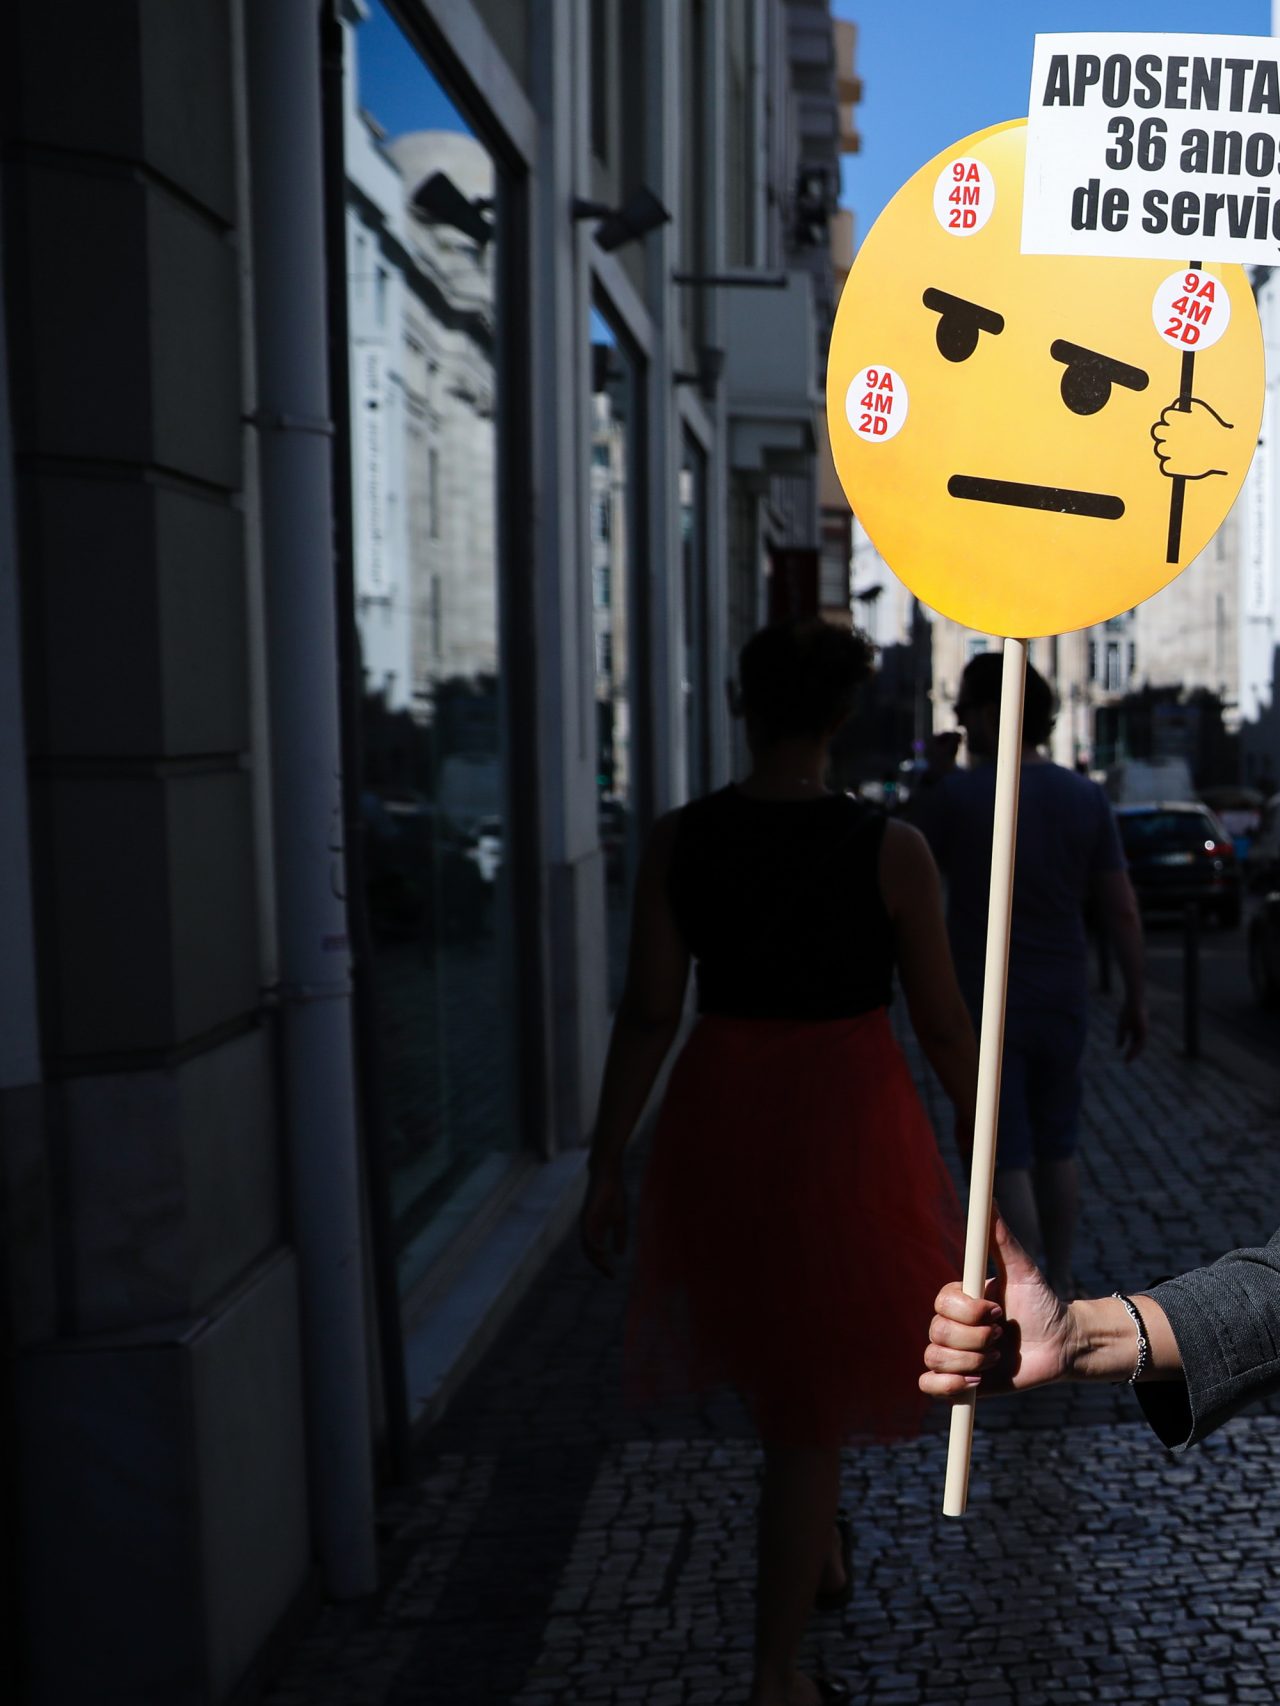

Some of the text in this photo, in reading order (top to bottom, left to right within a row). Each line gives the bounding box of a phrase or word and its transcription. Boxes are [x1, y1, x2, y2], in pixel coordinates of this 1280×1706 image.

[1105, 116, 1168, 171] 36
[953, 162, 981, 183] 9A
[948, 185, 981, 205] 4M
[1071, 178, 1130, 231] de
[948, 208, 977, 229] 2D
[1183, 272, 1215, 303] 9A
[1171, 296, 1213, 325] 4M
[1164, 316, 1201, 345] 2D
[866, 369, 894, 392] 9A
[860, 391, 894, 414] 4M
[859, 413, 888, 436] 2D
